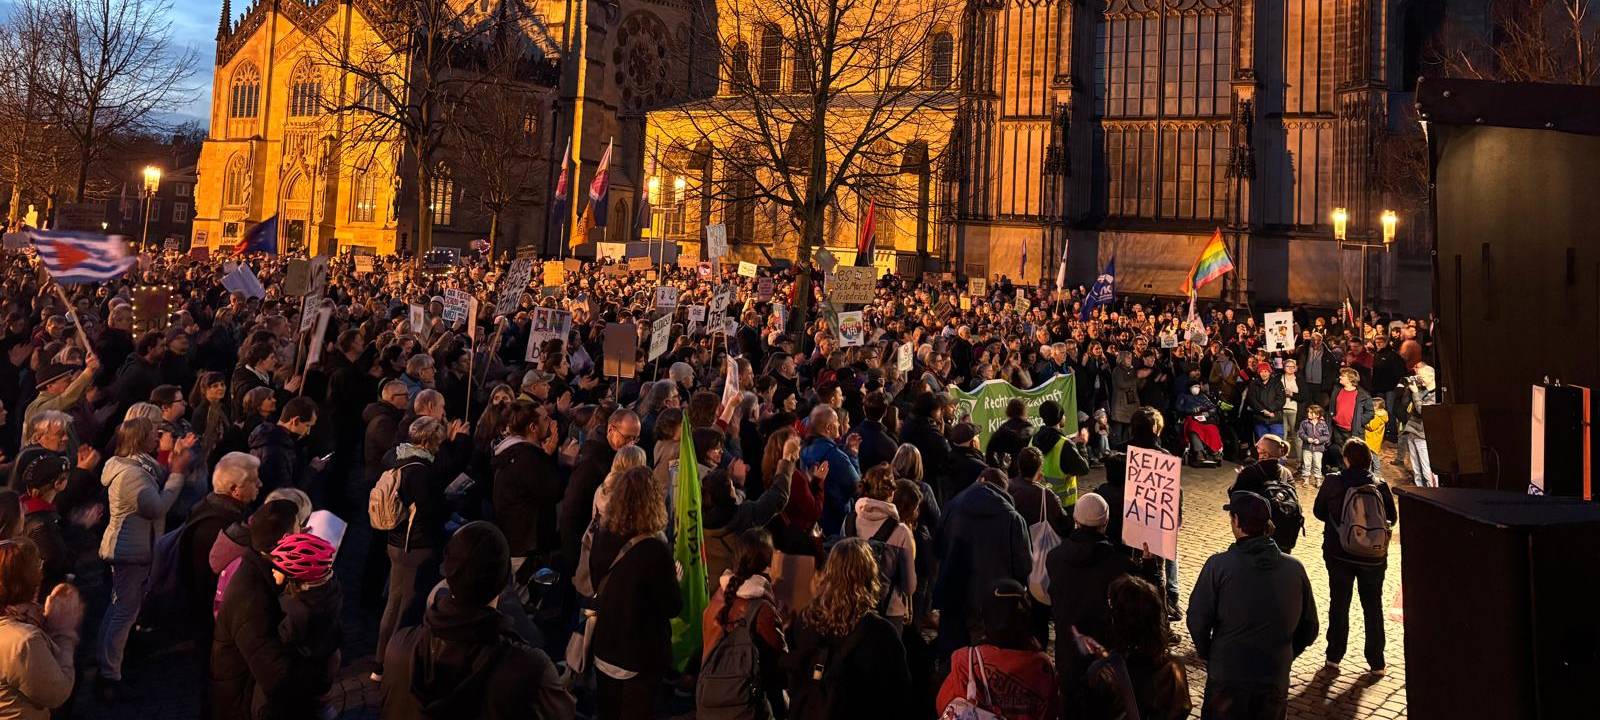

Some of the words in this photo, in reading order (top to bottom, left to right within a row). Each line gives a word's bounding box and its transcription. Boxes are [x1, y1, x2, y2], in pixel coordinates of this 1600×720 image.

[1129, 450, 1175, 472] KEIN
[1128, 465, 1175, 491] PLATZ
[1135, 485, 1174, 512] FÜR
[1125, 498, 1175, 531] AFD
